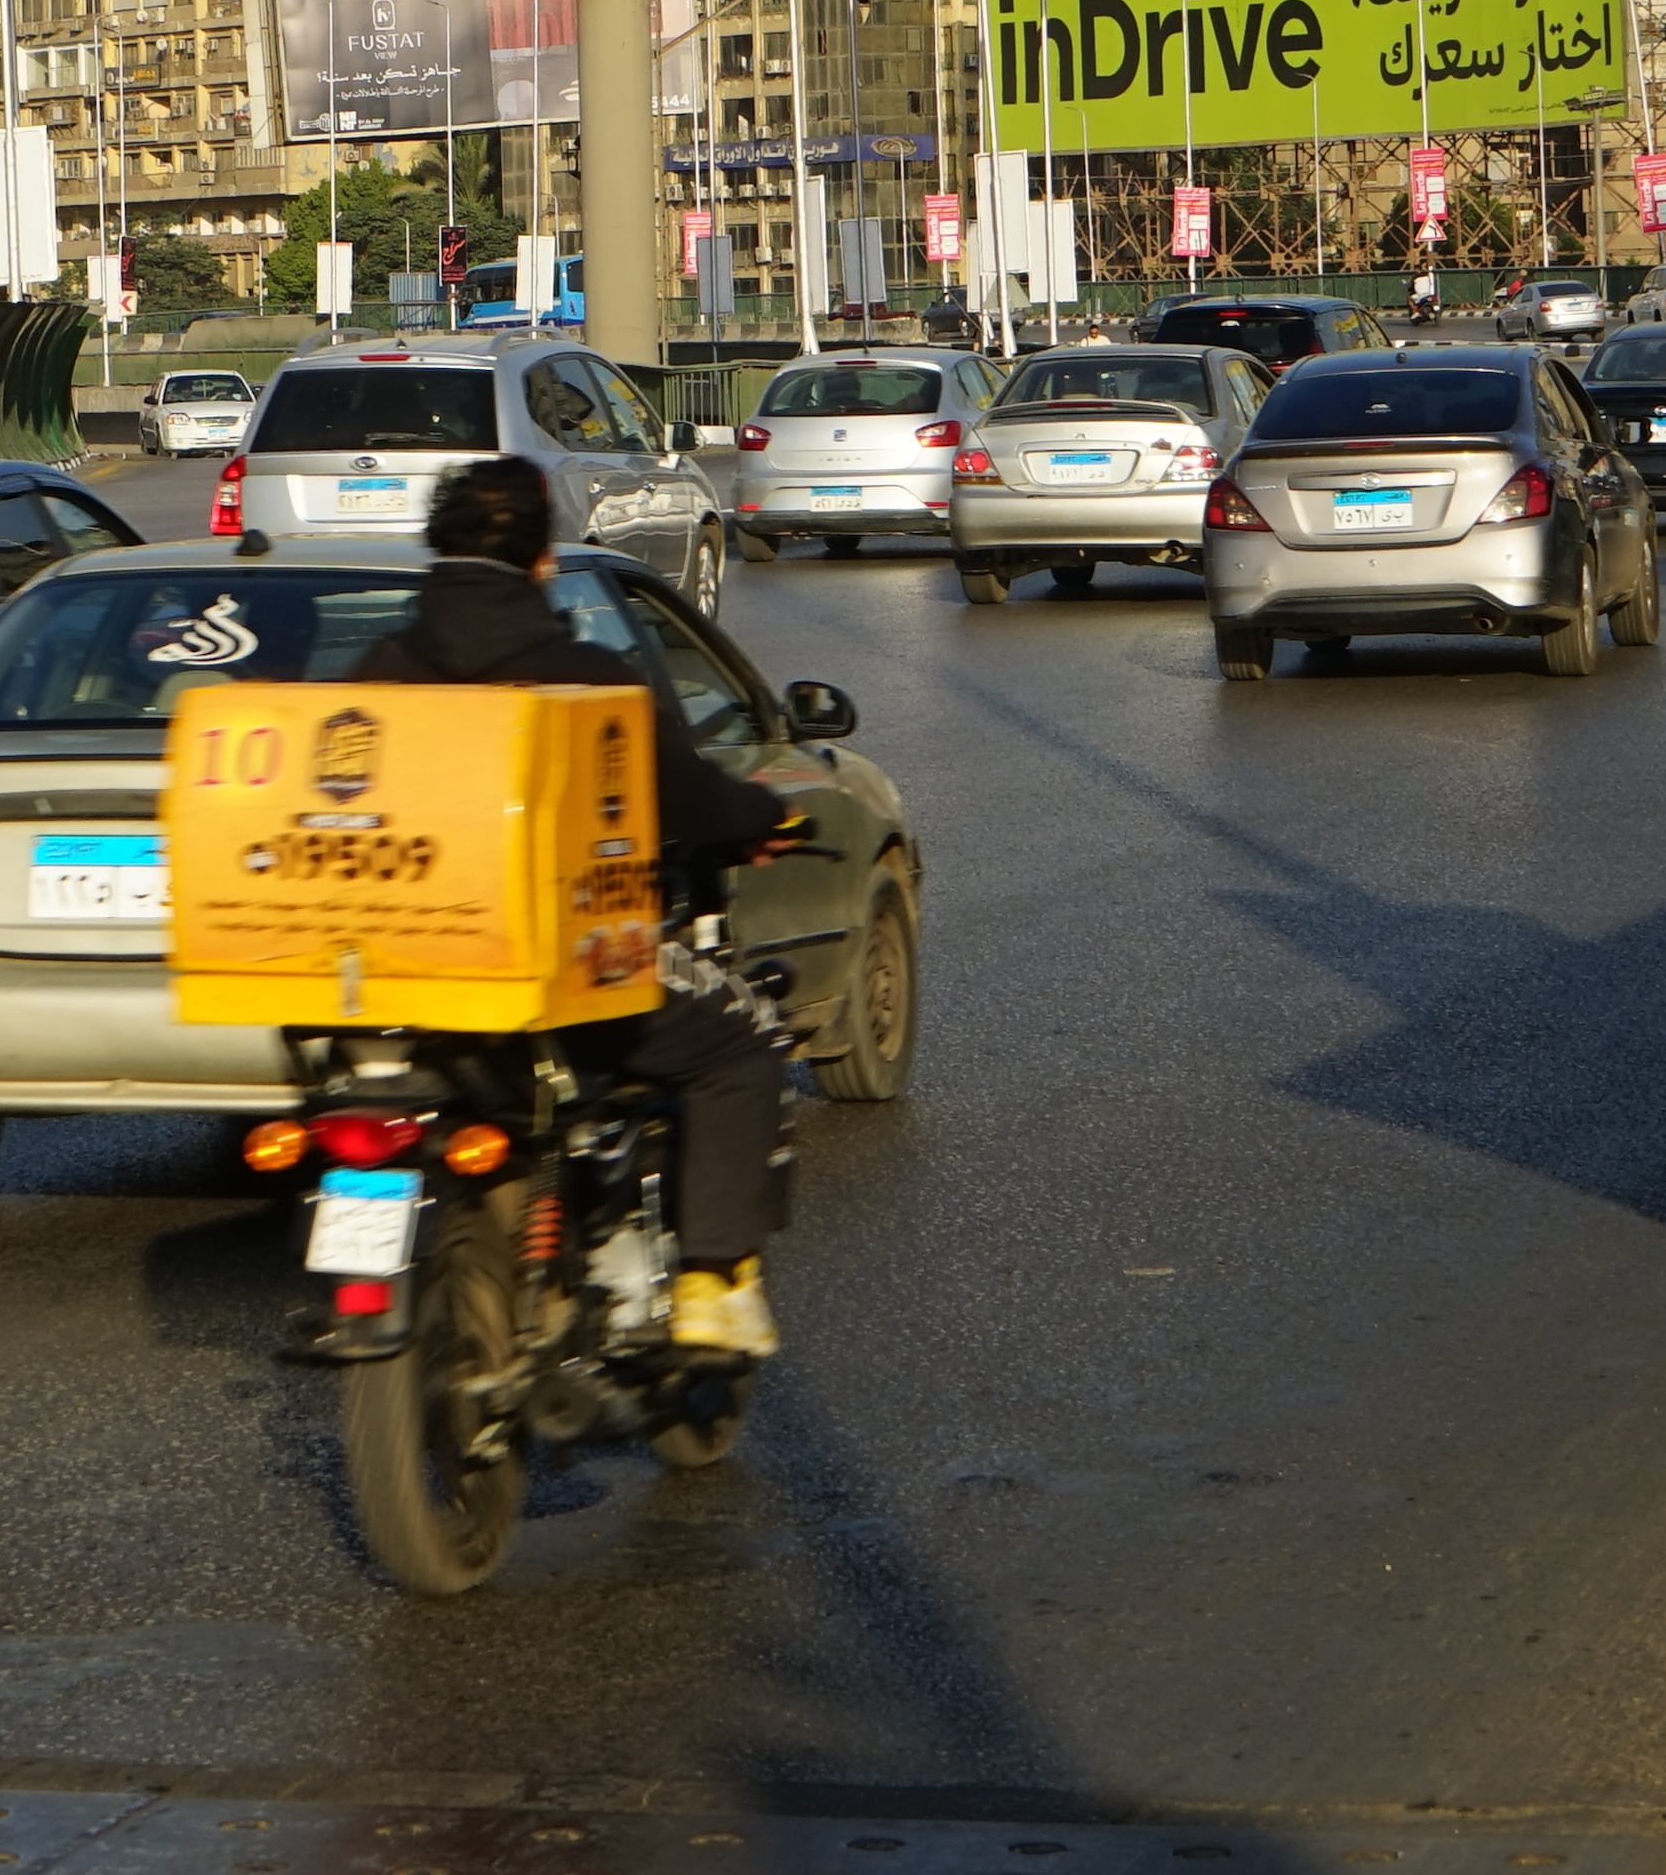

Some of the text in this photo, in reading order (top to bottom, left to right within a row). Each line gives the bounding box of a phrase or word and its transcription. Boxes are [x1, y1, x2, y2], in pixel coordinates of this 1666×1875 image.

[347, 32, 425, 52] FUSTAT
[374, 51, 398, 61] VIEW
[1380, 2, 1613, 101] اختار سعرك
[187, 727, 285, 787] 10
